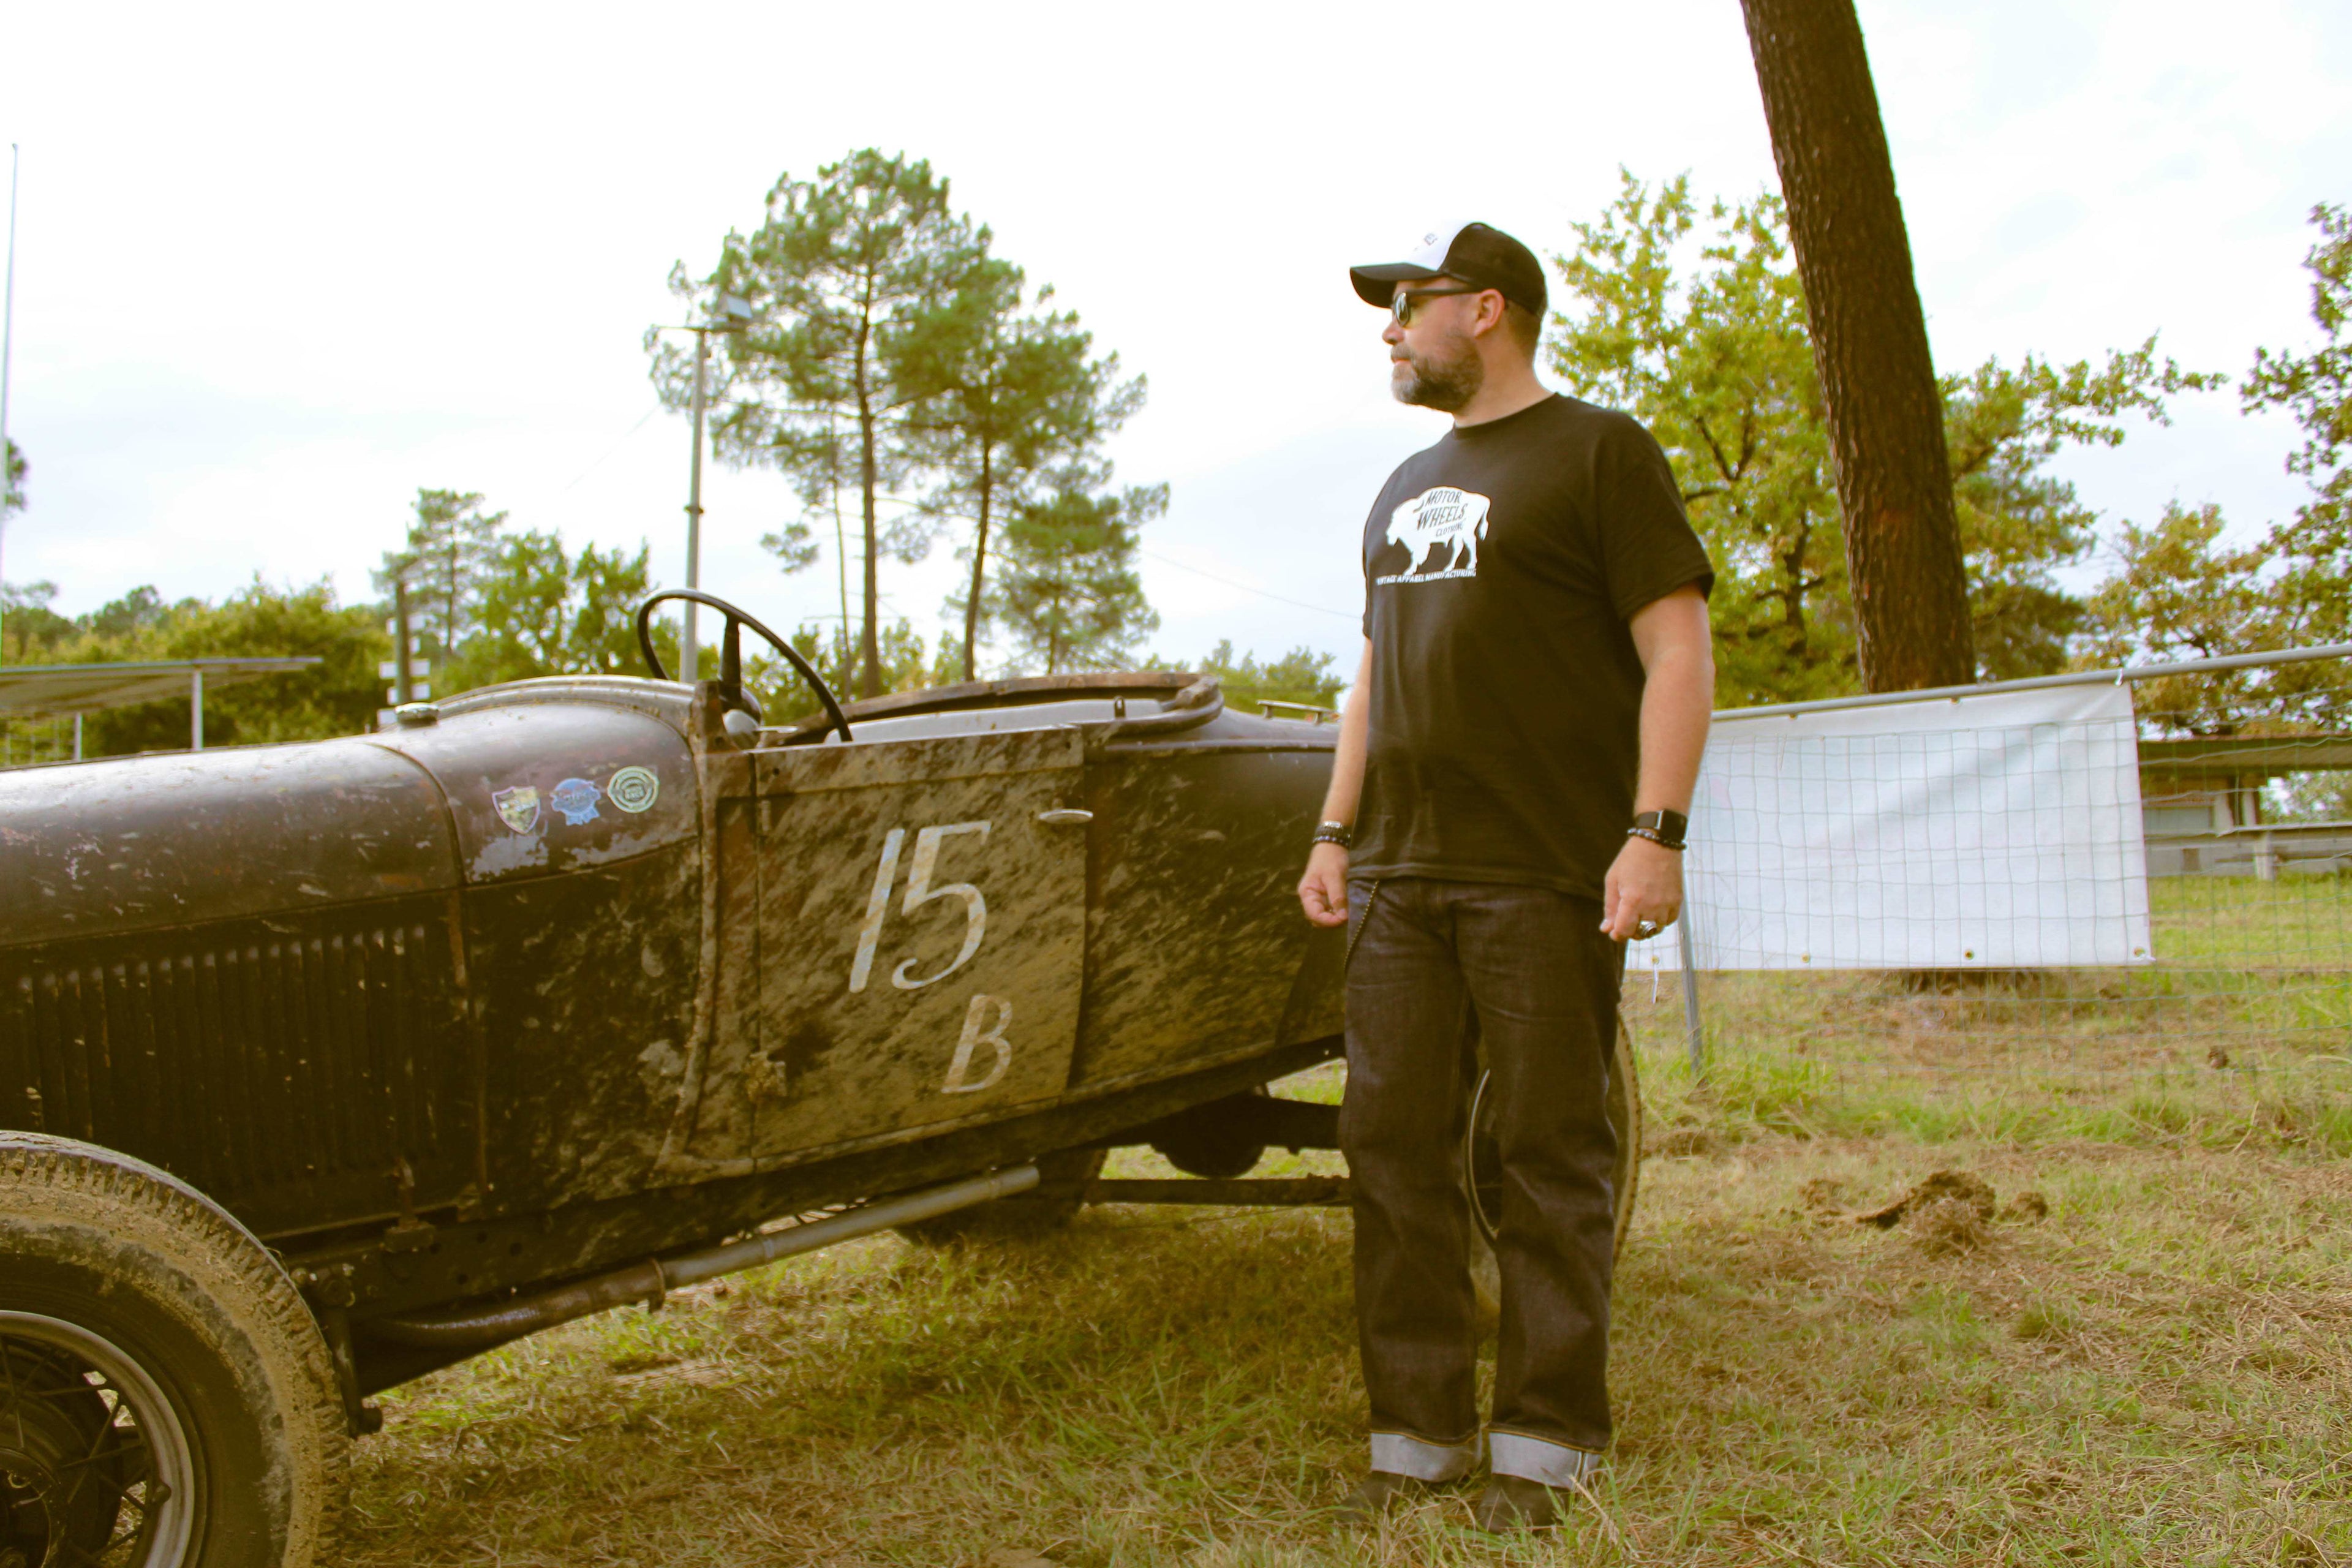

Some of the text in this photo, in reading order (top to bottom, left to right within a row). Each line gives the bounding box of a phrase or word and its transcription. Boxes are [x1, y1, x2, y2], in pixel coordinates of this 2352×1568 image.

[1425, 491, 1461, 507] MOTOR
[1417, 503, 1468, 530] WHEELS
[1436, 521, 1464, 537] CLOTHING
[1397, 574, 1425, 582] APPAREL
[1425, 568, 1477, 581] MANUFACTURING
[850, 821, 992, 993] 15
[941, 994, 1013, 1095] B
